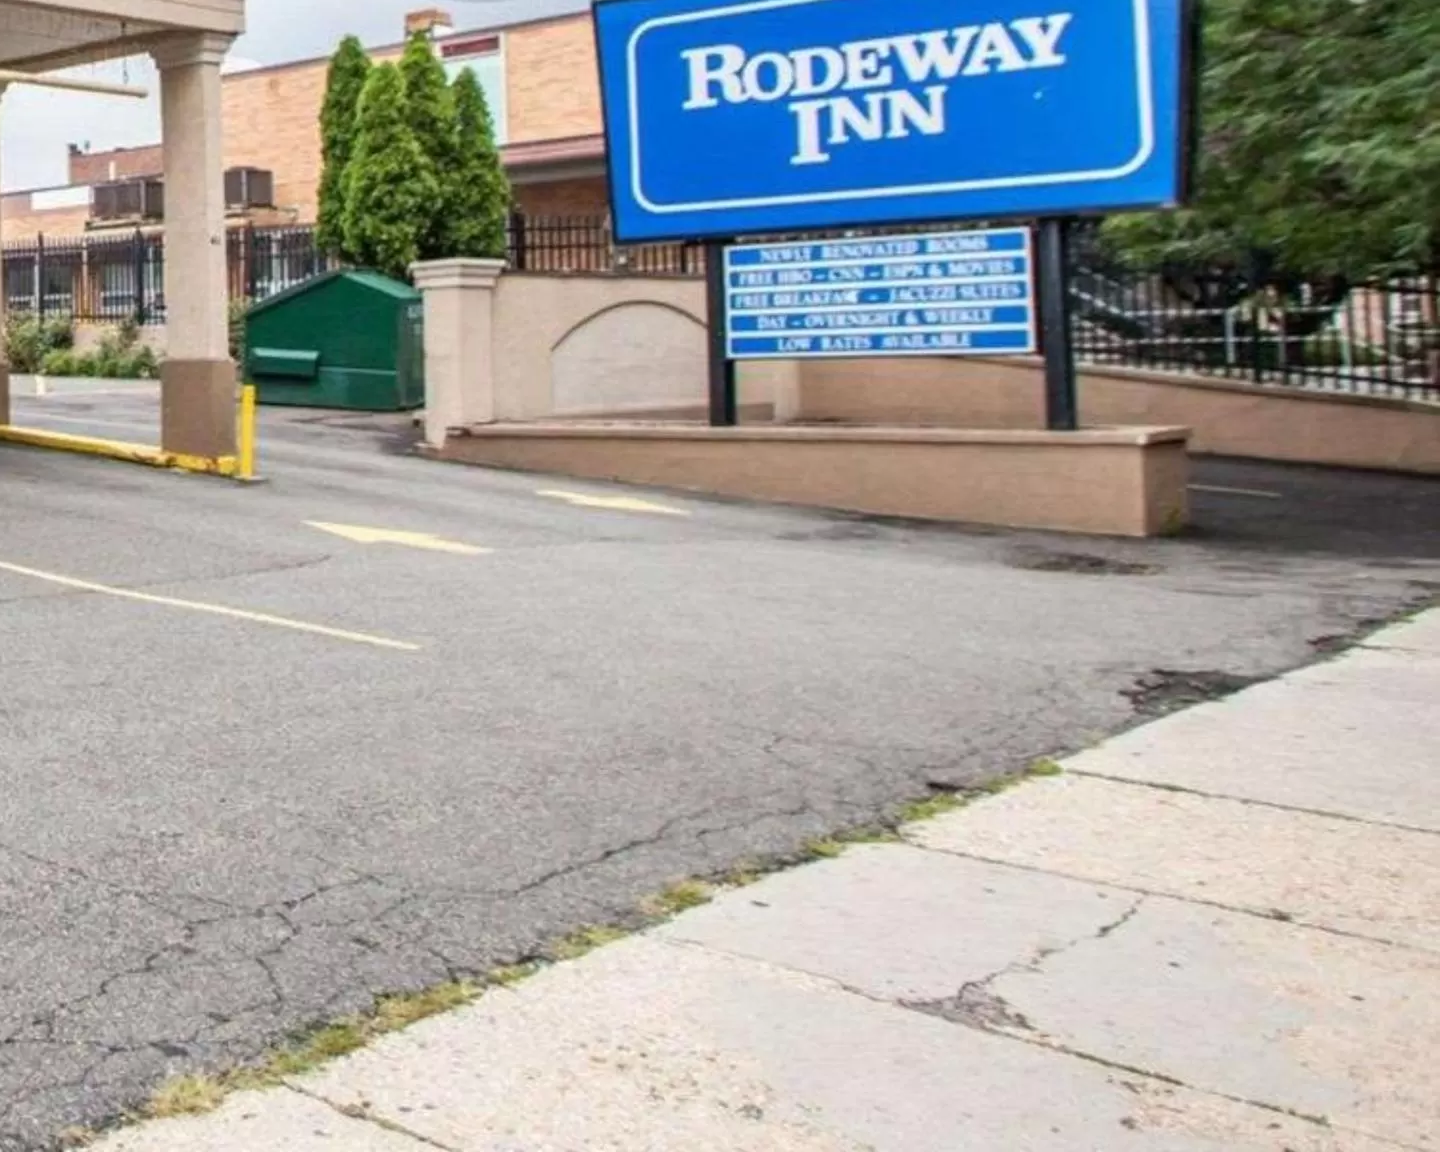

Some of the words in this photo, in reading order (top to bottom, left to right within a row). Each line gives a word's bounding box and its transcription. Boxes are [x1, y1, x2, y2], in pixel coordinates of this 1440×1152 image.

[681, 12, 1073, 110] RODEWAY
[788, 85, 948, 166] INN
[821, 240, 919, 259] RENOVATED
[926, 235, 988, 253] ROOMS
[738, 270, 774, 286] FREE
[778, 267, 813, 283] HBO
[827, 265, 864, 282] CNN
[883, 262, 924, 278] ESPN
[948, 258, 1015, 275] MOVIES
[959, 281, 1021, 299] SUITES
[757, 313, 787, 329] DAY
[804, 310, 899, 328] OVERNIGHT
[923, 307, 993, 324] WEEKLY
[778, 337, 810, 352] LOW
[821, 334, 872, 350] RATES
